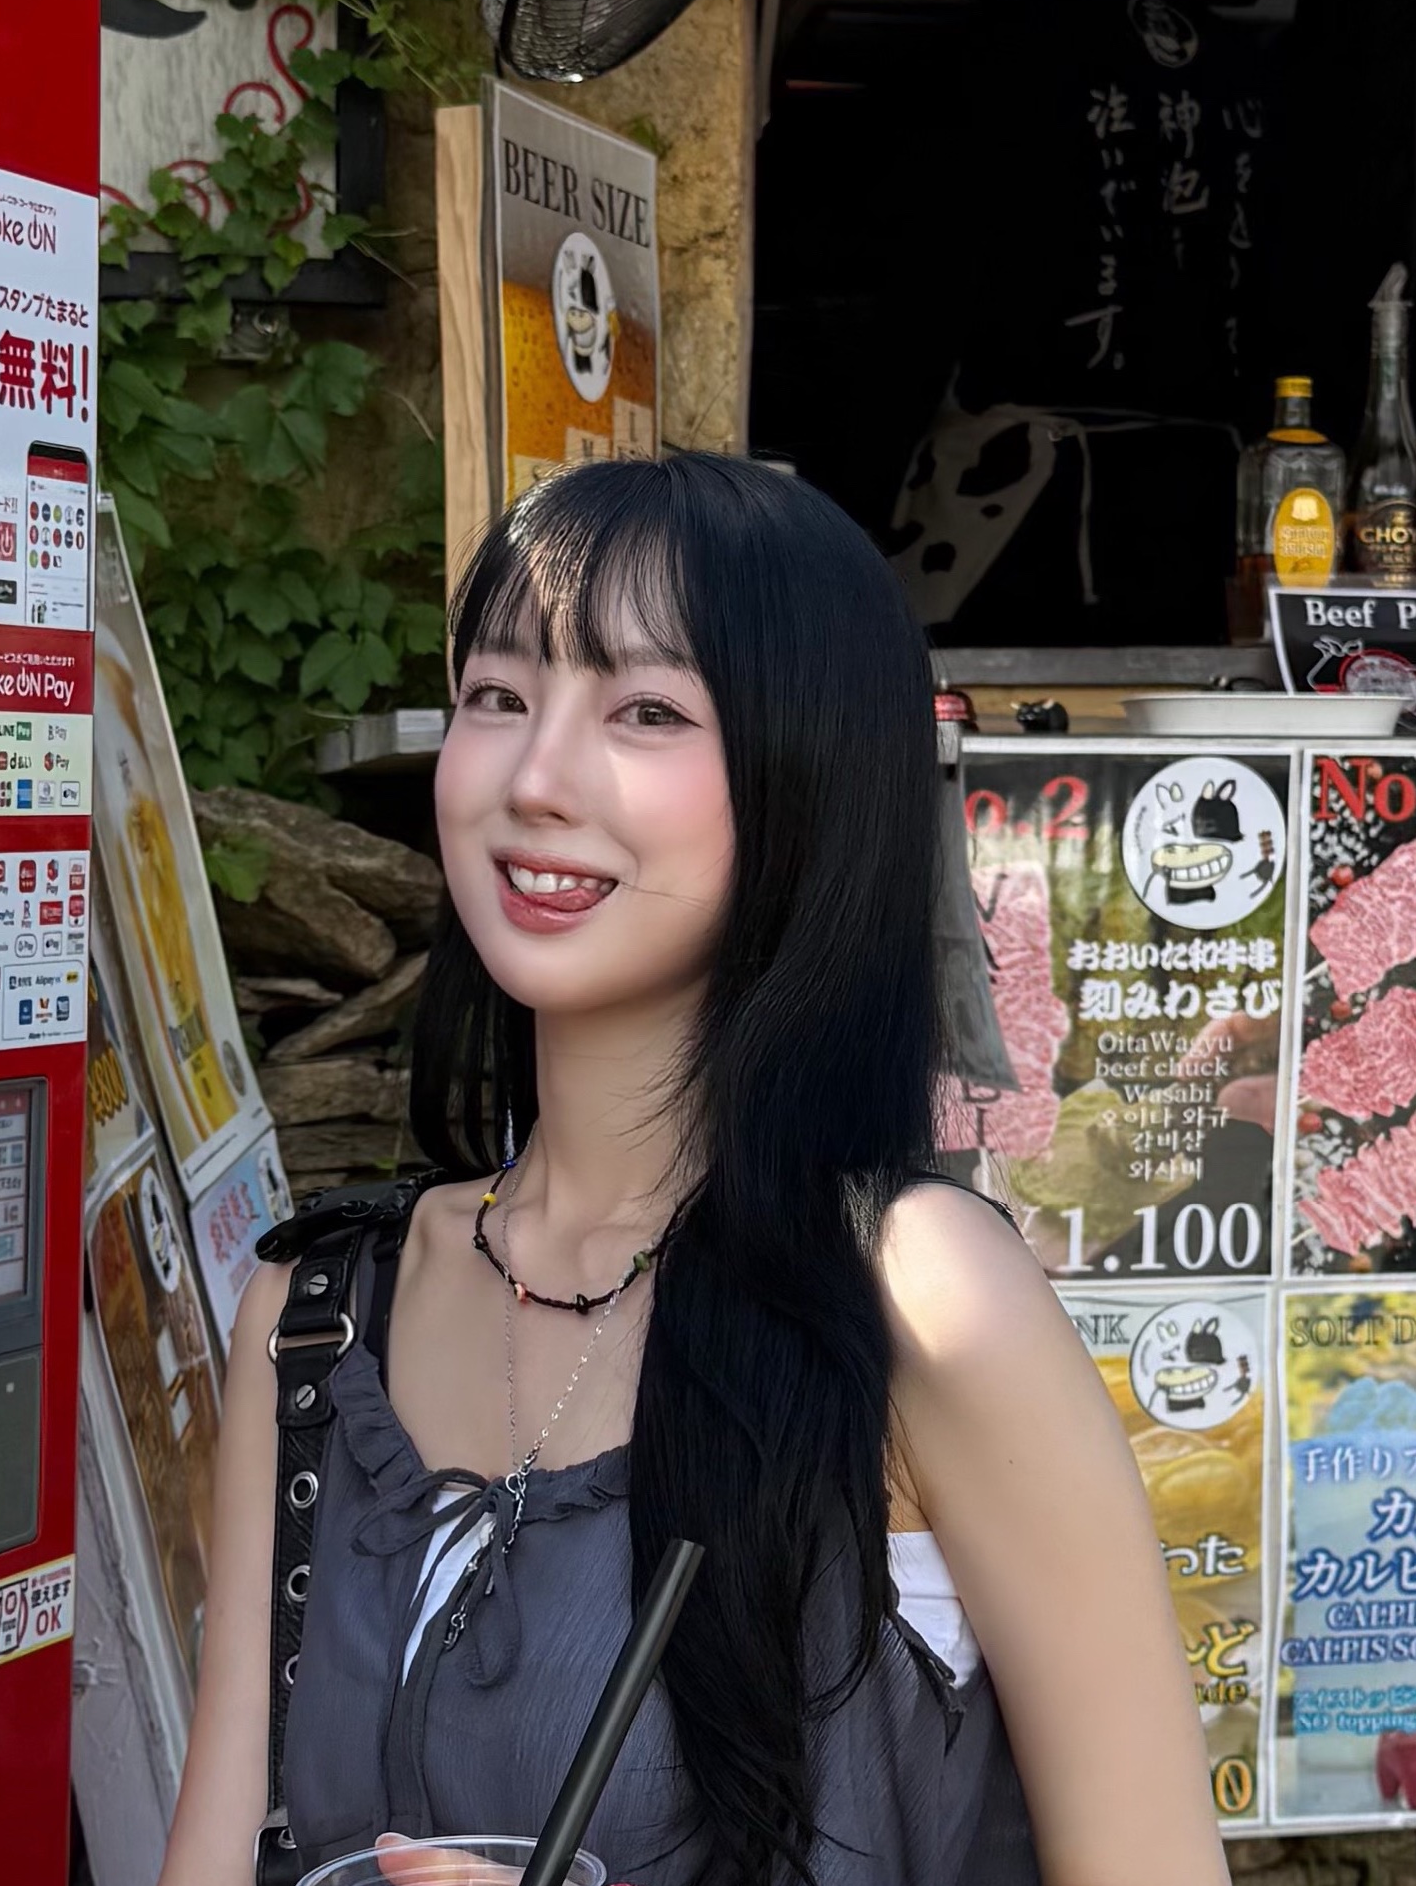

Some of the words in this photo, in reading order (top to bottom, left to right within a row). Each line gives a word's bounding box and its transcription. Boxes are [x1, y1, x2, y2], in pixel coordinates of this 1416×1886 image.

[503, 136, 586, 221] BEER
[589, 175, 653, 251] SIZE
[1304, 597, 1375, 629] Beef
[1067, 939, 1277, 972] おおいた和牛串
[1076, 979, 1281, 1021] 刻みわさび
[1094, 1055, 1151, 1078] beef
[1154, 1056, 1230, 1078] chuck
[1123, 1082, 1212, 1103] Wasabi
[1289, 1315, 1386, 1349] SOFT
[36, 1603, 63, 1636] OK
[1296, 1710, 1335, 1731] NO
